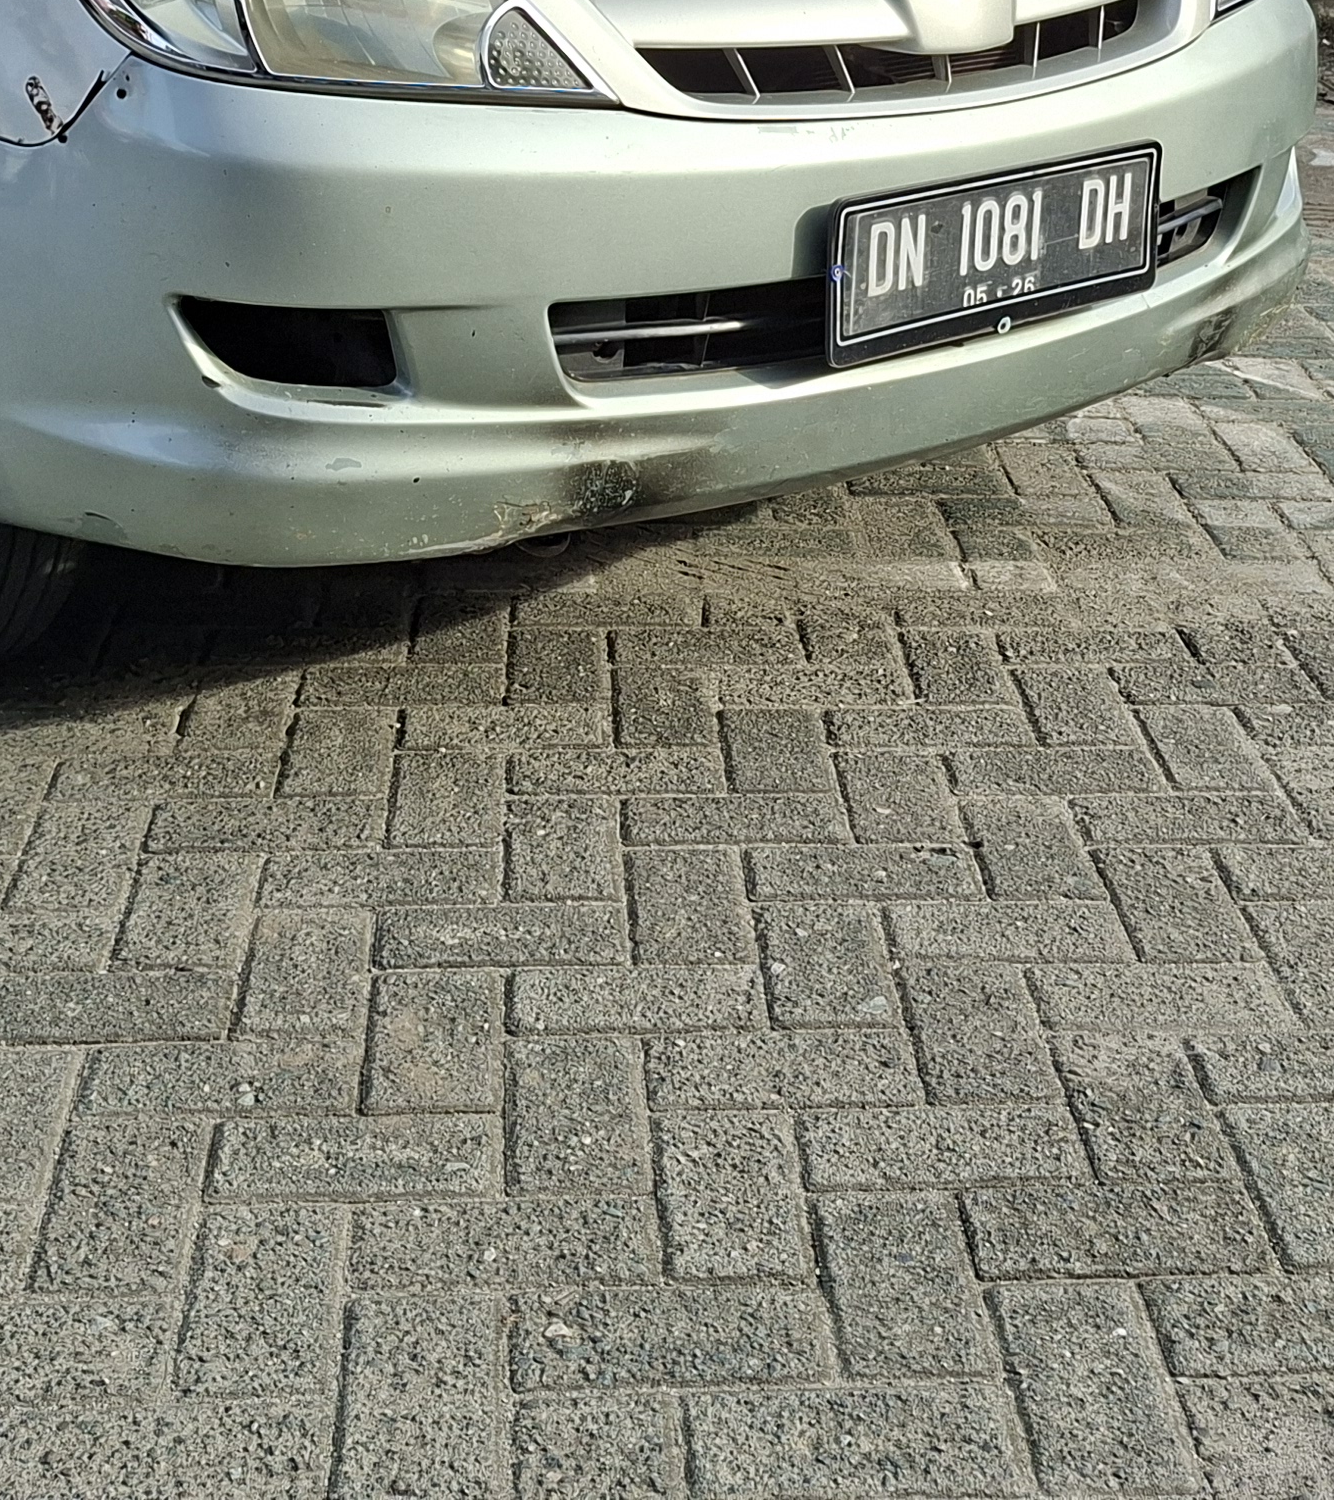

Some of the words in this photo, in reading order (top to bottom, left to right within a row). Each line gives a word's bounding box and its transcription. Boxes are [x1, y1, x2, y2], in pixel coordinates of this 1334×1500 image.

[867, 214, 926, 298] DN
[959, 187, 1043, 277] 1081
[1078, 172, 1133, 249] DH
